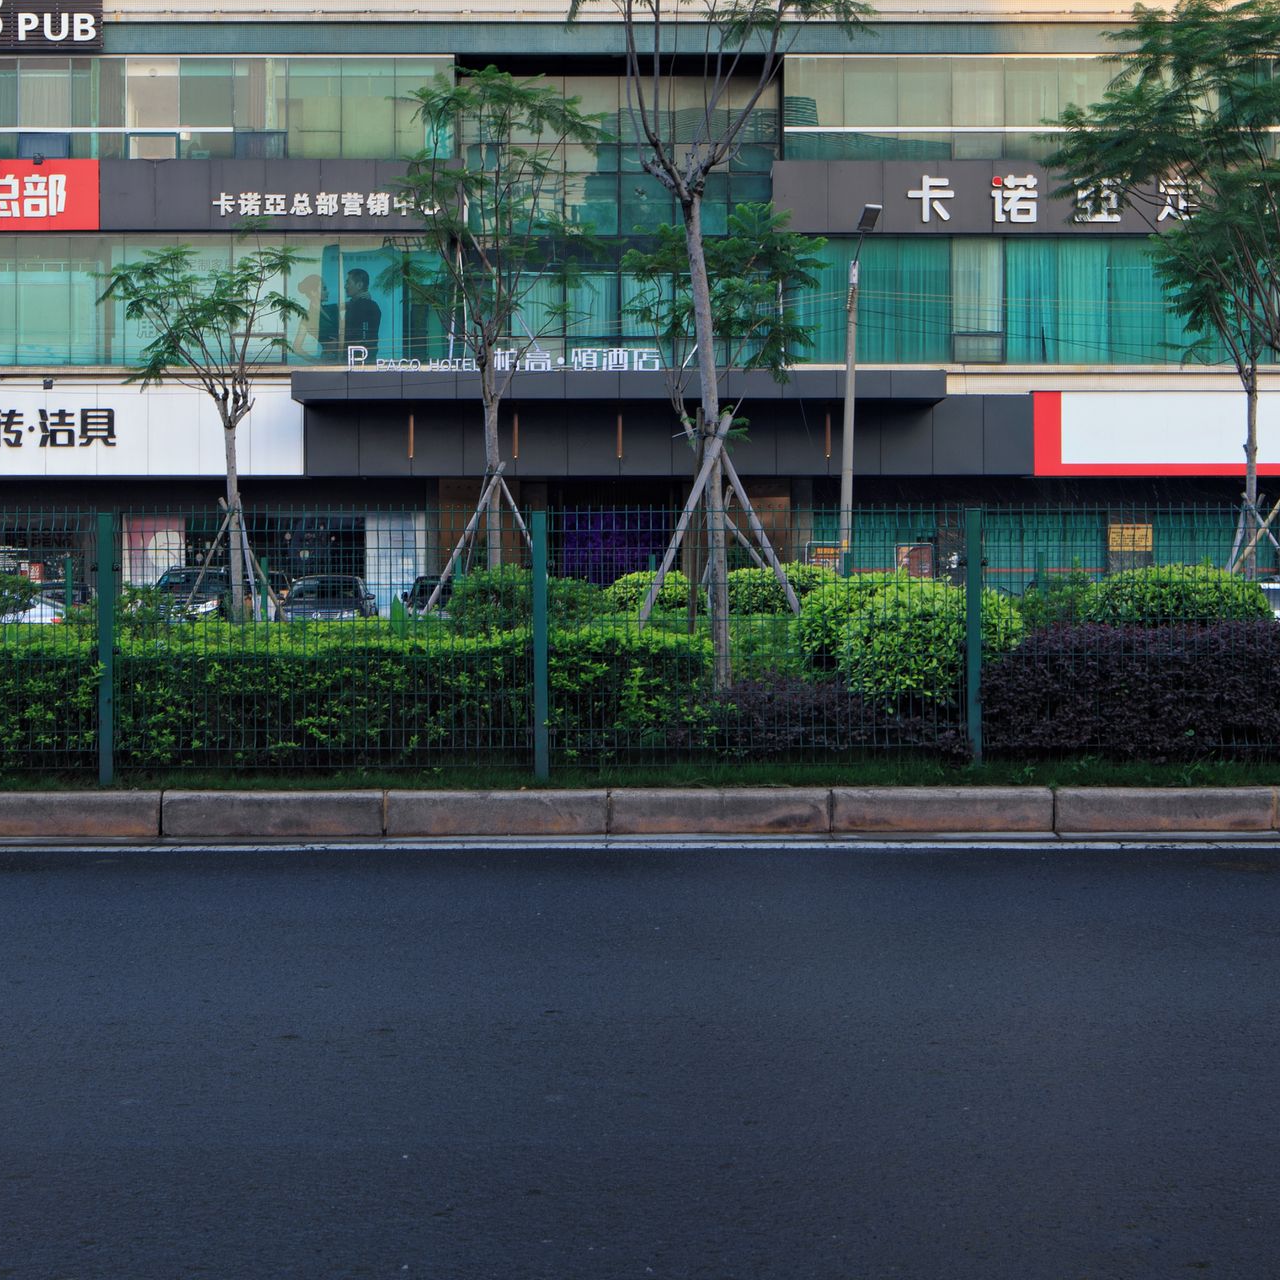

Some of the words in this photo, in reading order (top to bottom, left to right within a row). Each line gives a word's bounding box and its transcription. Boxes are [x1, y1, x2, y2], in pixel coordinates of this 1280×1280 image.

[18, 12, 97, 42] PUB
[376, 358, 421, 371] PACO
[429, 357, 481, 371] HOTEL
